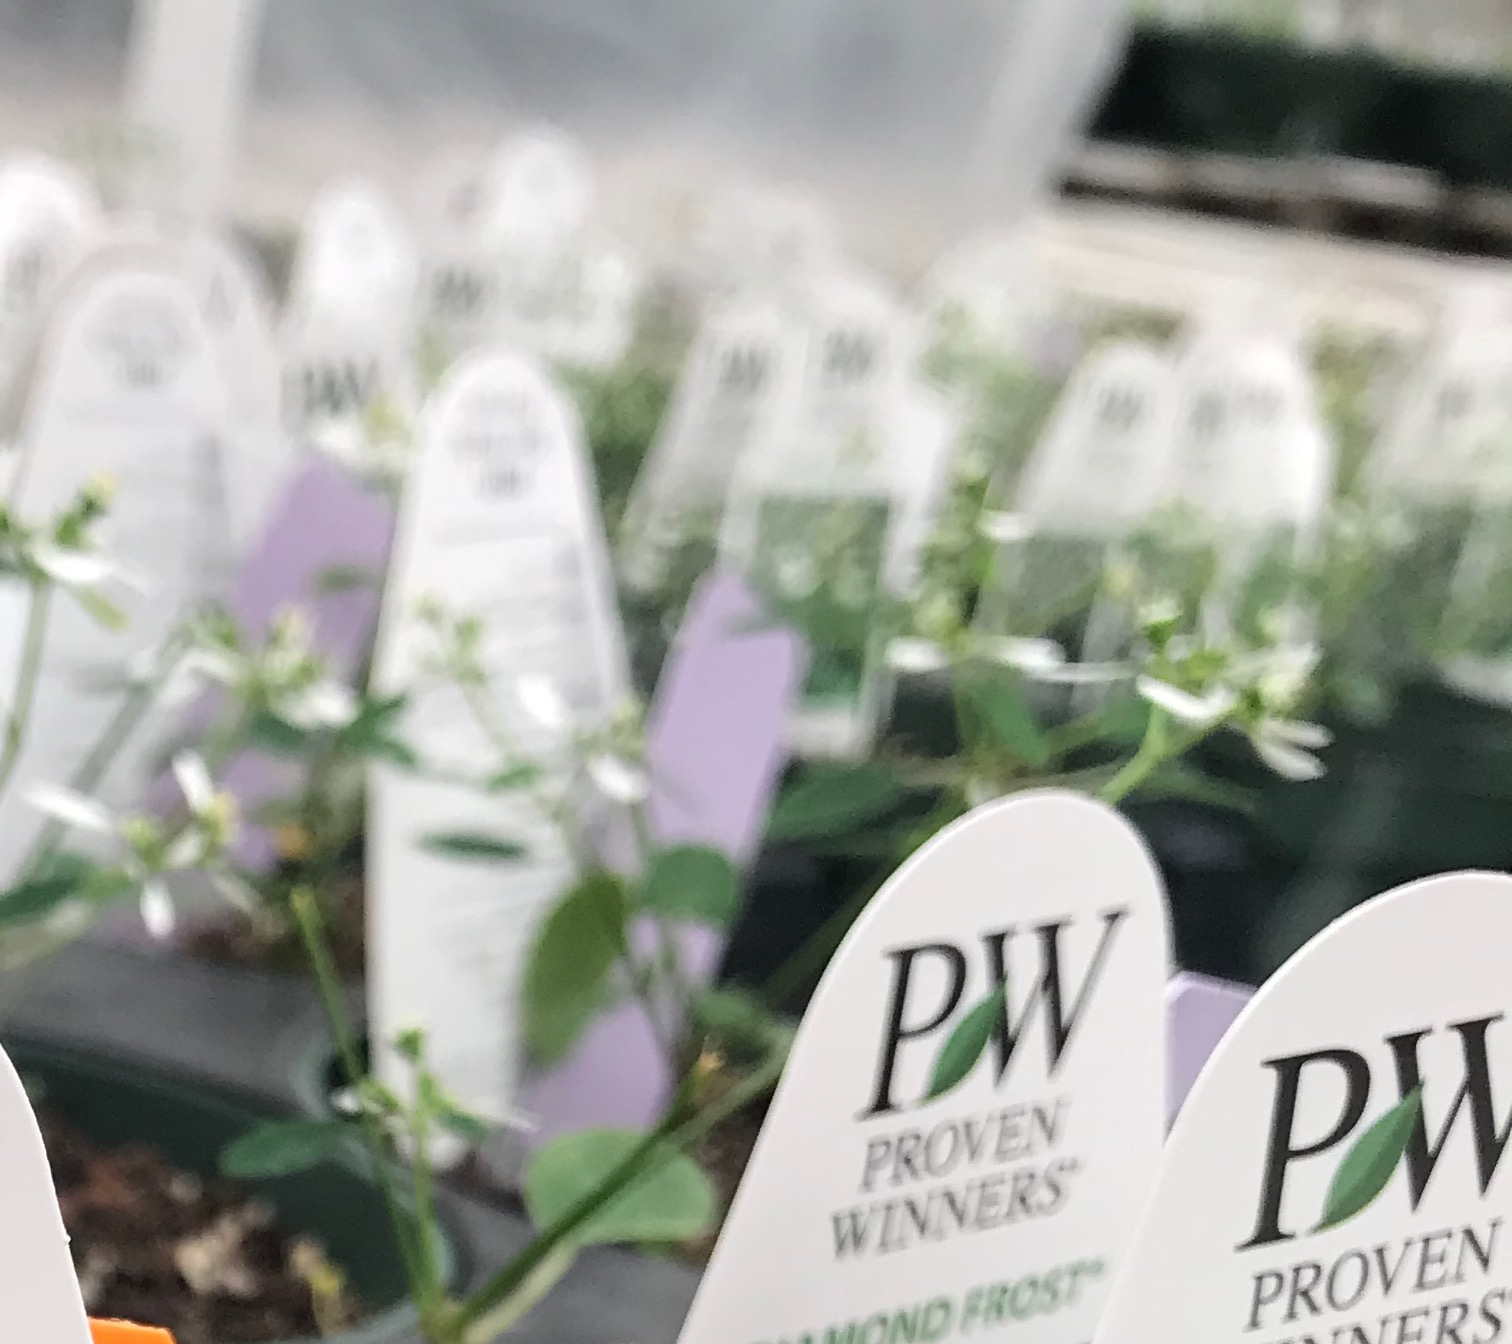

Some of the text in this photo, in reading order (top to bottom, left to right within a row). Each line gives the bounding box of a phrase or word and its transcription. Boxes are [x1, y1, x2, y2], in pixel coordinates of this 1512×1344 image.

[853, 906, 1130, 1122] PW
[860, 1097, 1070, 1193] PROVEN
[1243, 1217, 1503, 1332] PROVEN
